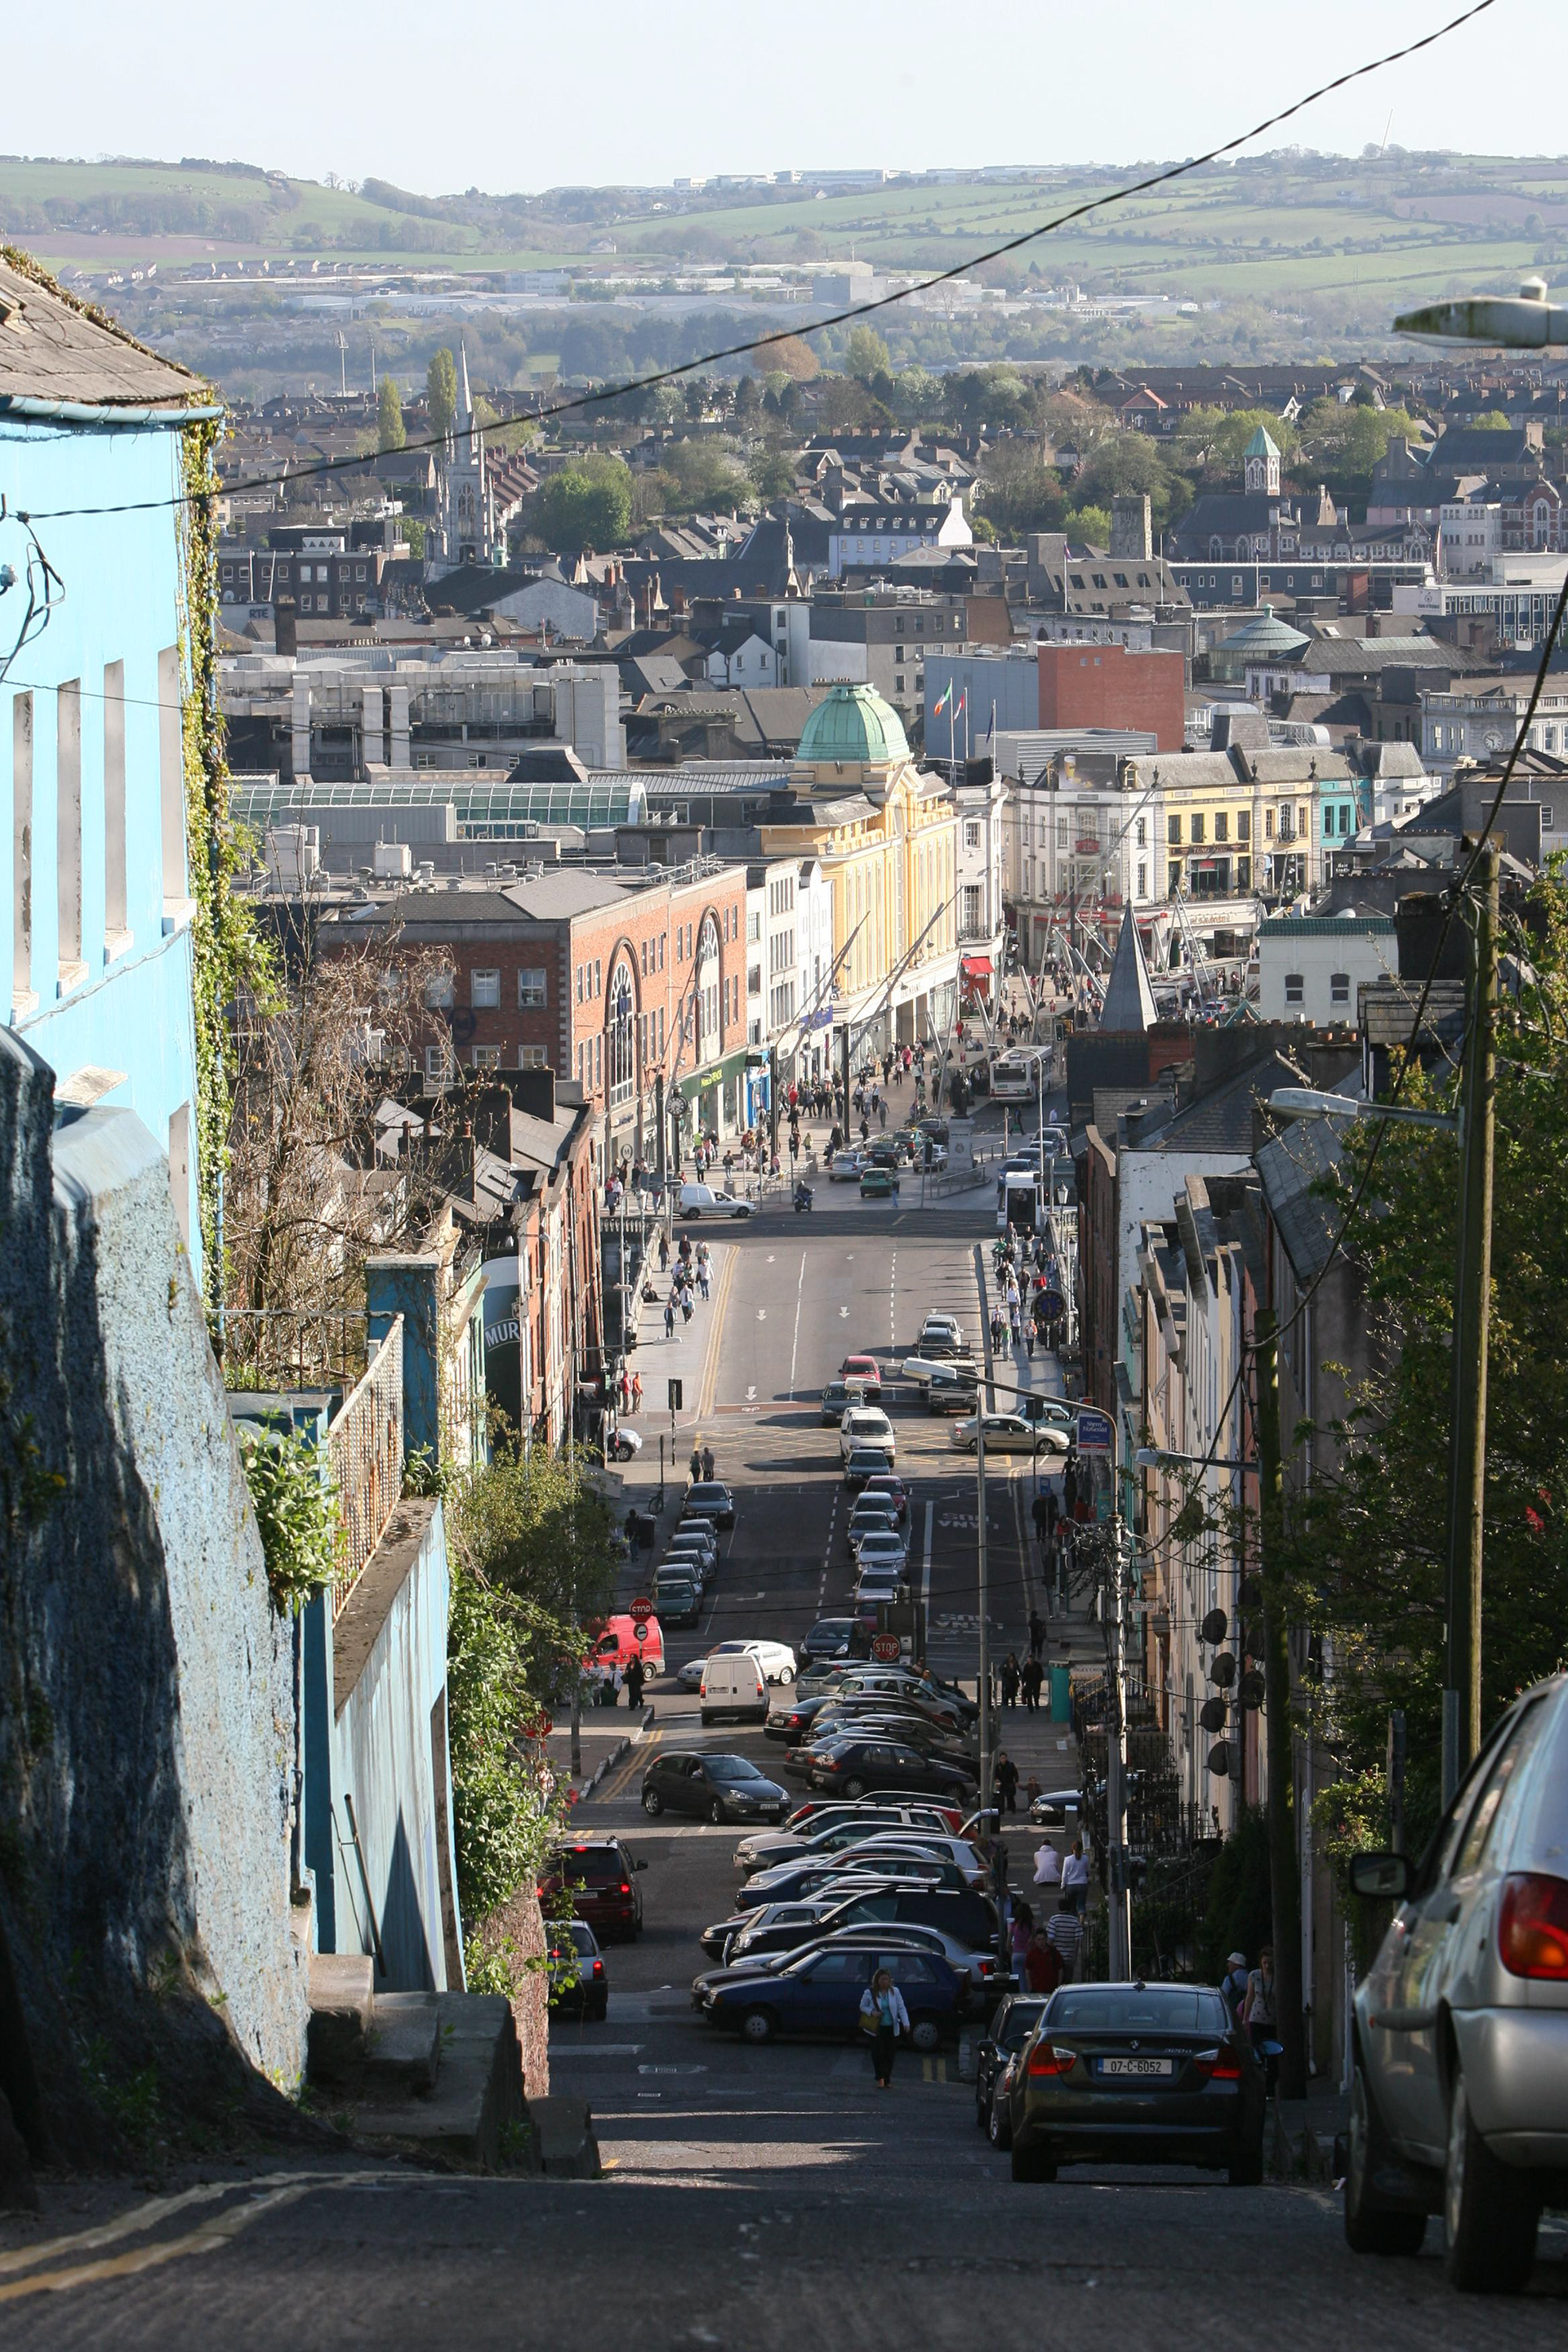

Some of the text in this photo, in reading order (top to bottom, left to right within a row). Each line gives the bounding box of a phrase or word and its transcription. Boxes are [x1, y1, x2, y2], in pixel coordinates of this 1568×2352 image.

[485, 1321, 520, 1348] MUR
[631, 1605, 651, 1616] STOP
[875, 1642, 898, 1652] STOP
[1111, 2060, 1161, 2073] 07-C-6052
